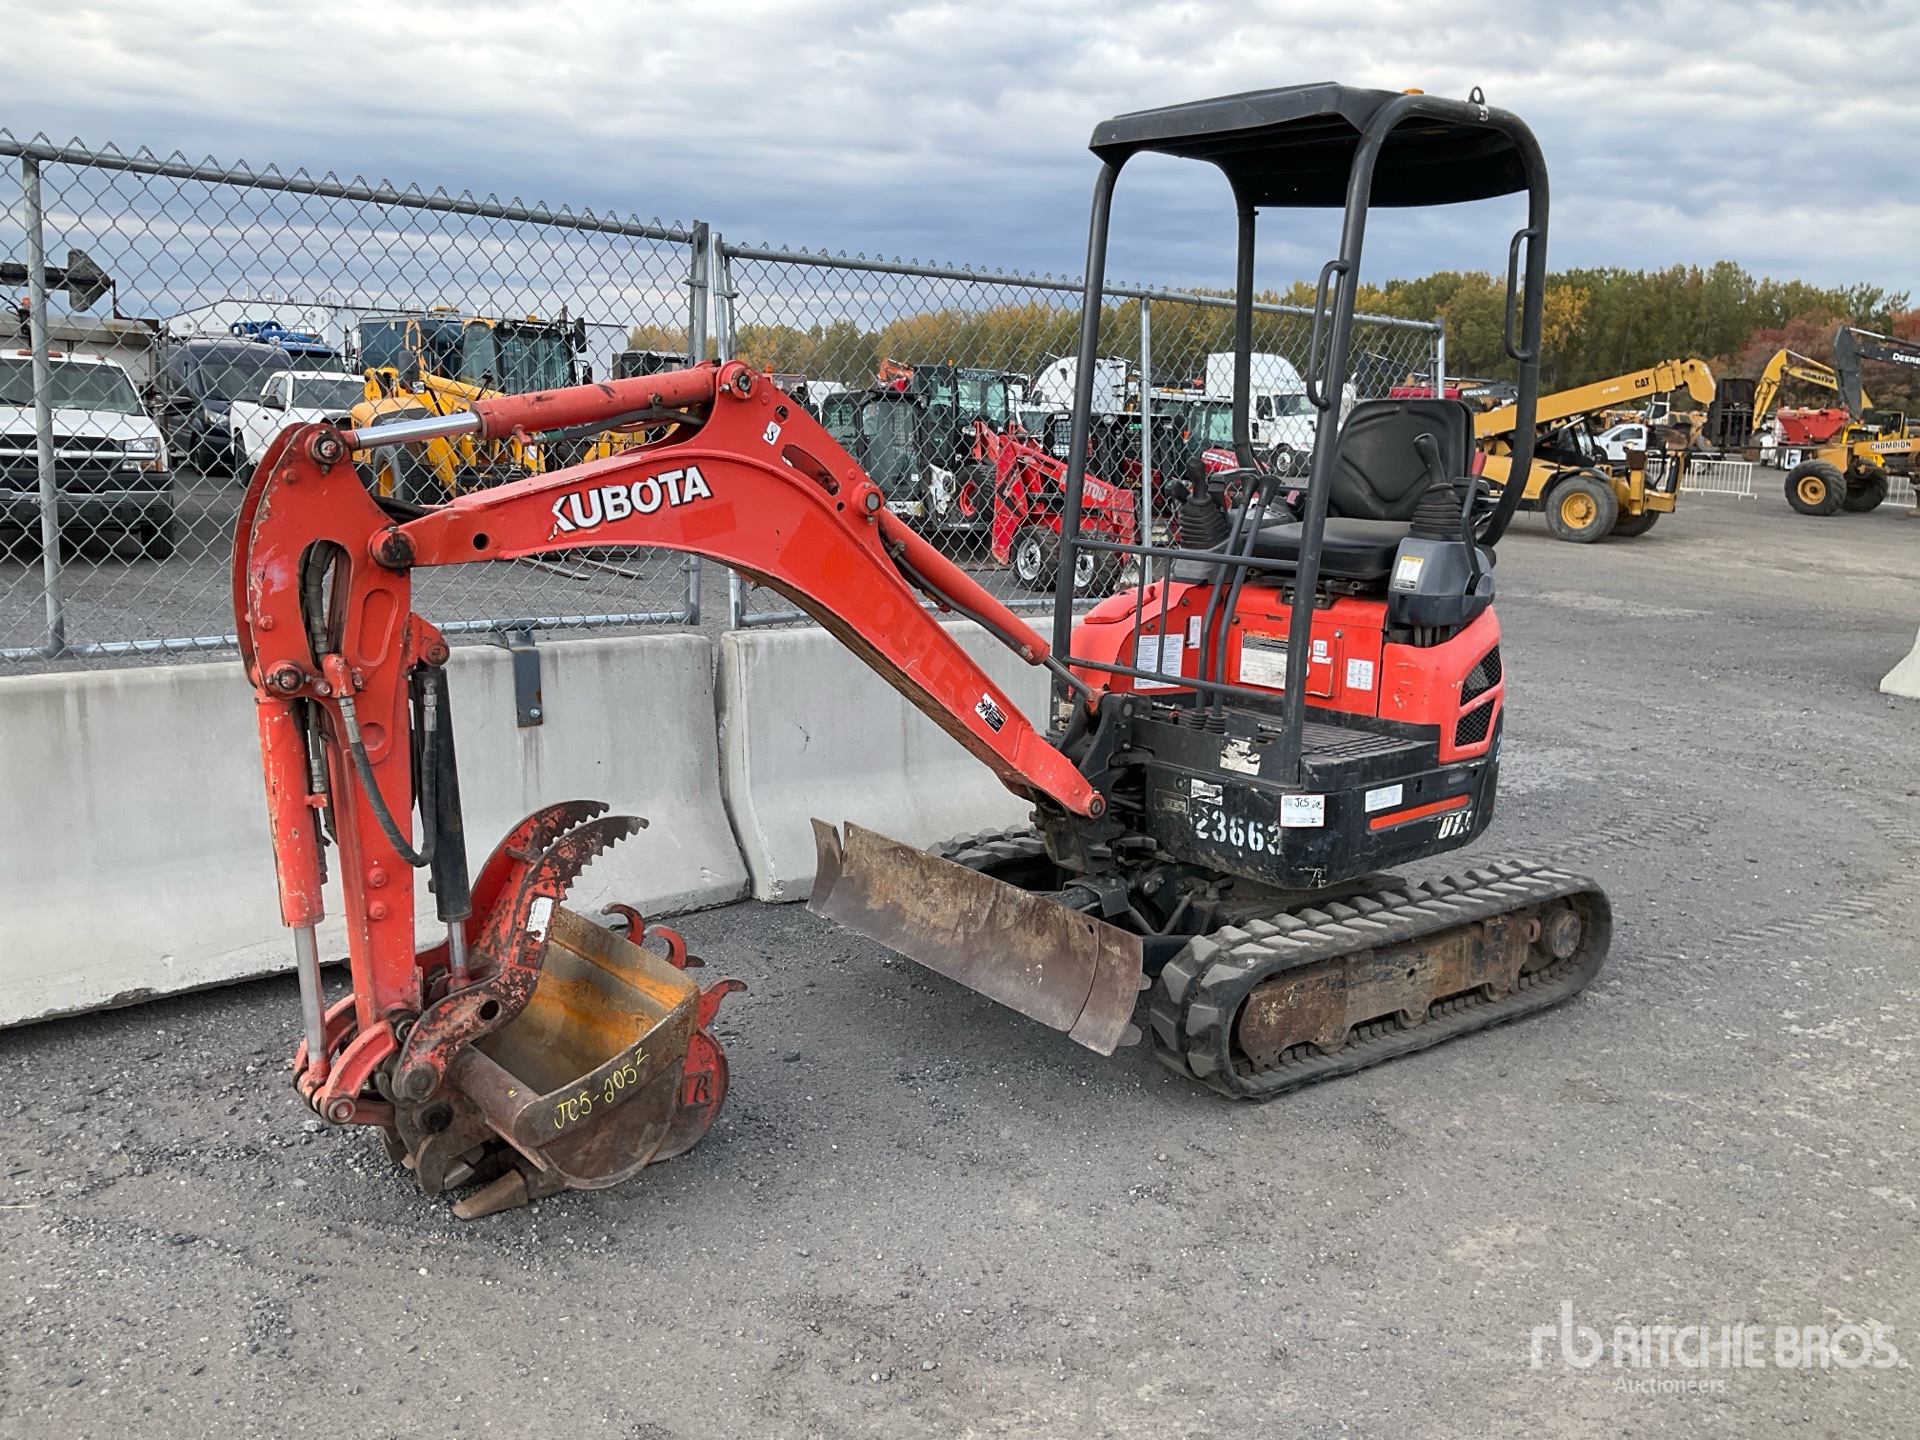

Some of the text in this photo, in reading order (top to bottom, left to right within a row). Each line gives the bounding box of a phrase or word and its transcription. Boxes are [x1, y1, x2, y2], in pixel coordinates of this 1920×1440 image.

[1892, 352, 1920, 364] DEERE
[1634, 377, 1650, 389] CAT
[1800, 370, 1835, 384] KOMATSU
[1869, 441, 1912, 451] CHAMPION
[553, 466, 713, 533] KUBOTA
